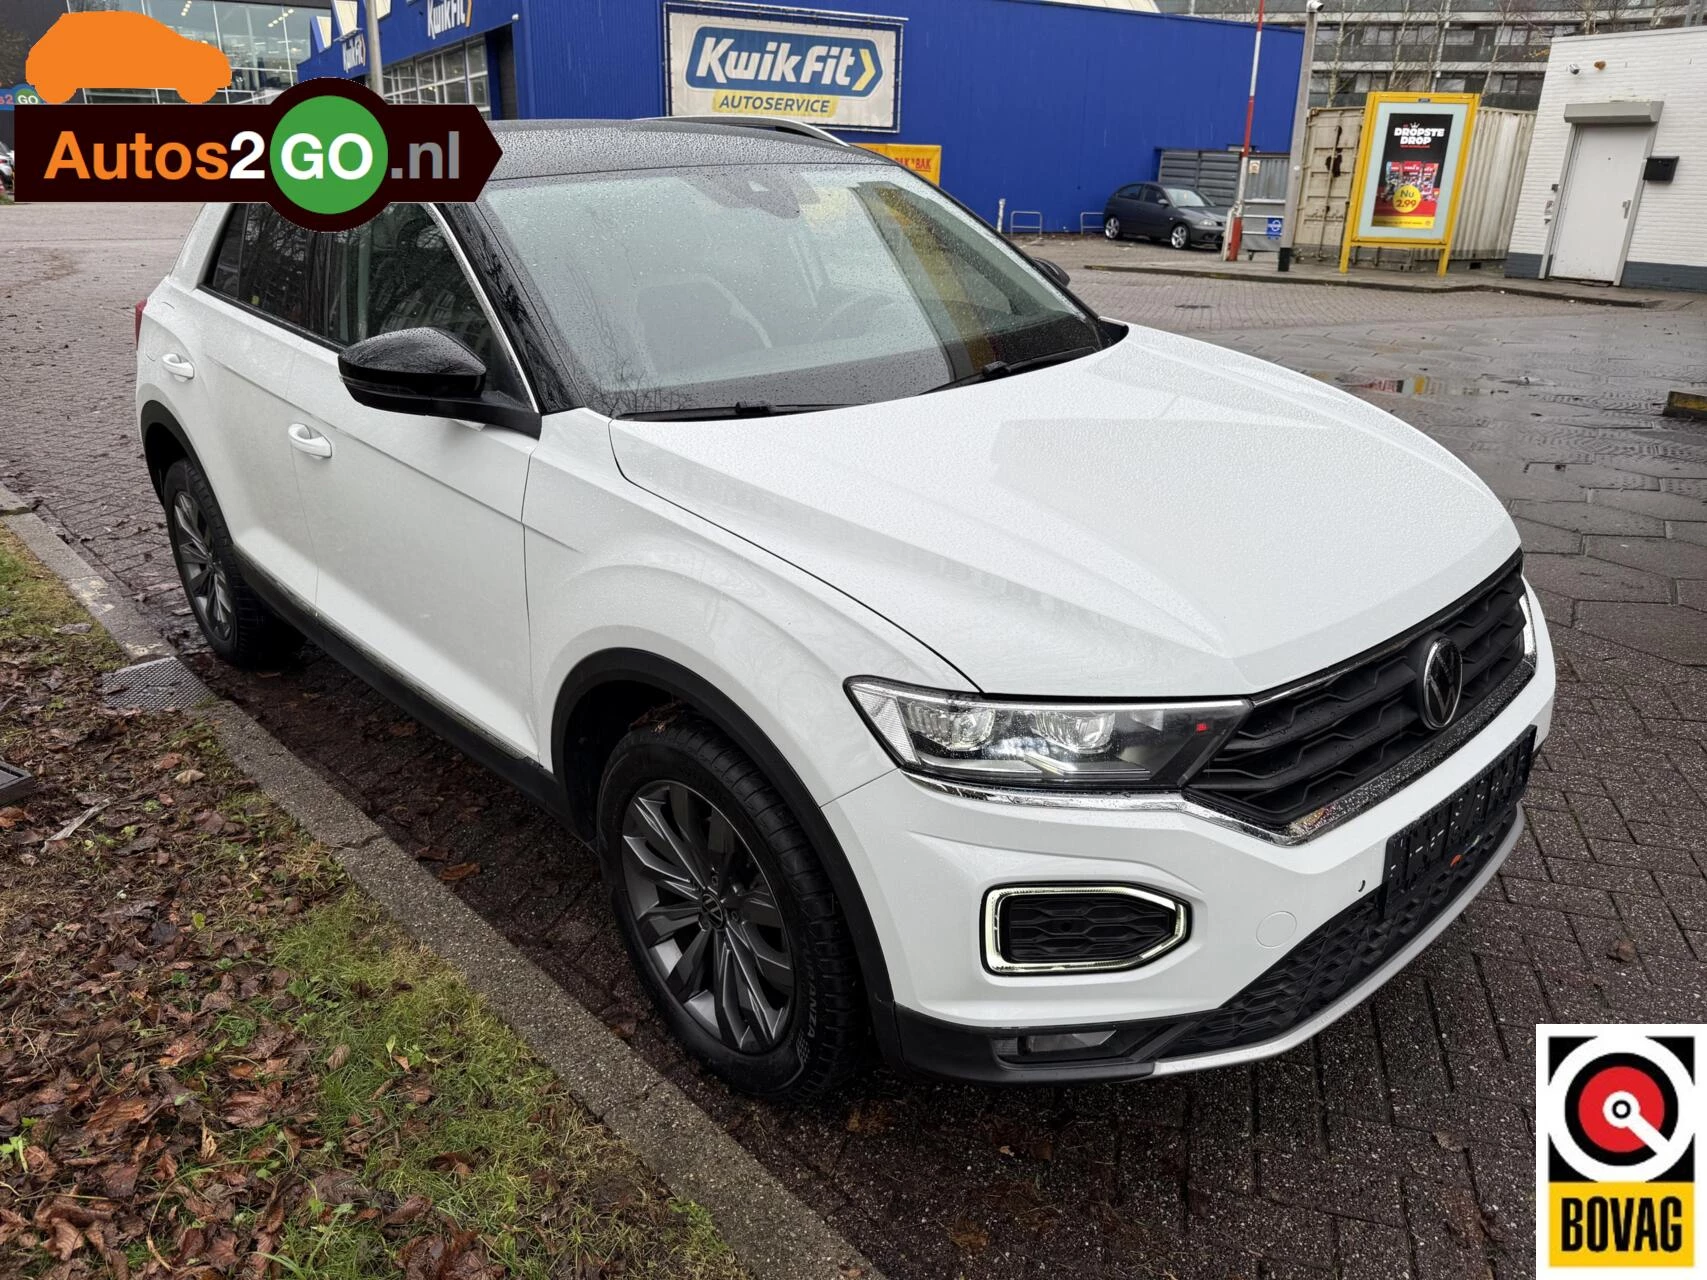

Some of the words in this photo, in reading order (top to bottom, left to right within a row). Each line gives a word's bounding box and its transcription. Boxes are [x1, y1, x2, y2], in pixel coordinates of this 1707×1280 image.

[719, 95, 831, 113] AUTOSERVICE
[1394, 127, 1445, 137] DROPSTE
[1400, 136, 1431, 145] DROP
[1400, 189, 1415, 198] Nu
[1396, 199, 1417, 208] 2.99
